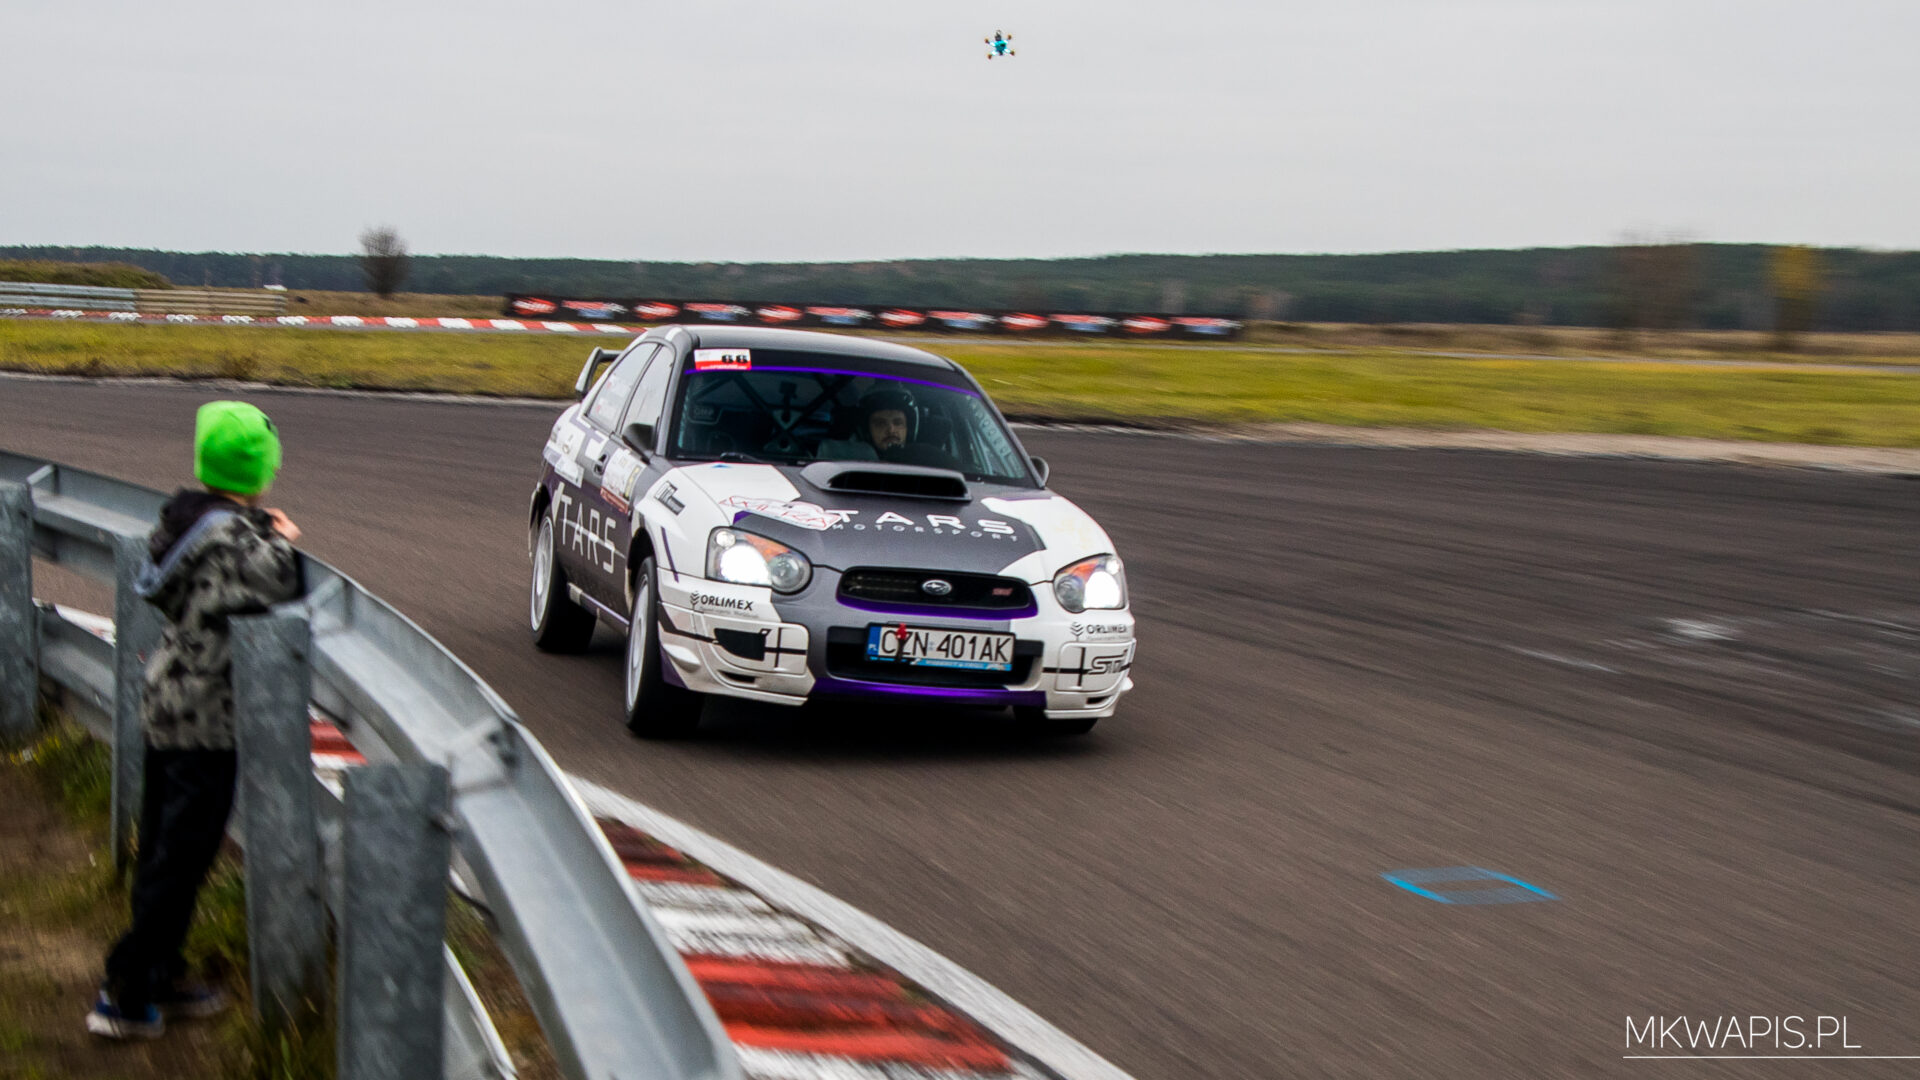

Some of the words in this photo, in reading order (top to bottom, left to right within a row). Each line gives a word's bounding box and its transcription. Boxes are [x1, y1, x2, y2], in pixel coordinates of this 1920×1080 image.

[559, 494, 616, 574] TARS
[824, 509, 1015, 535] TARS
[832, 523, 1018, 542] MOTORSPORT
[700, 594, 754, 611] ORLIMEX
[936, 633, 1012, 663] 401AK
